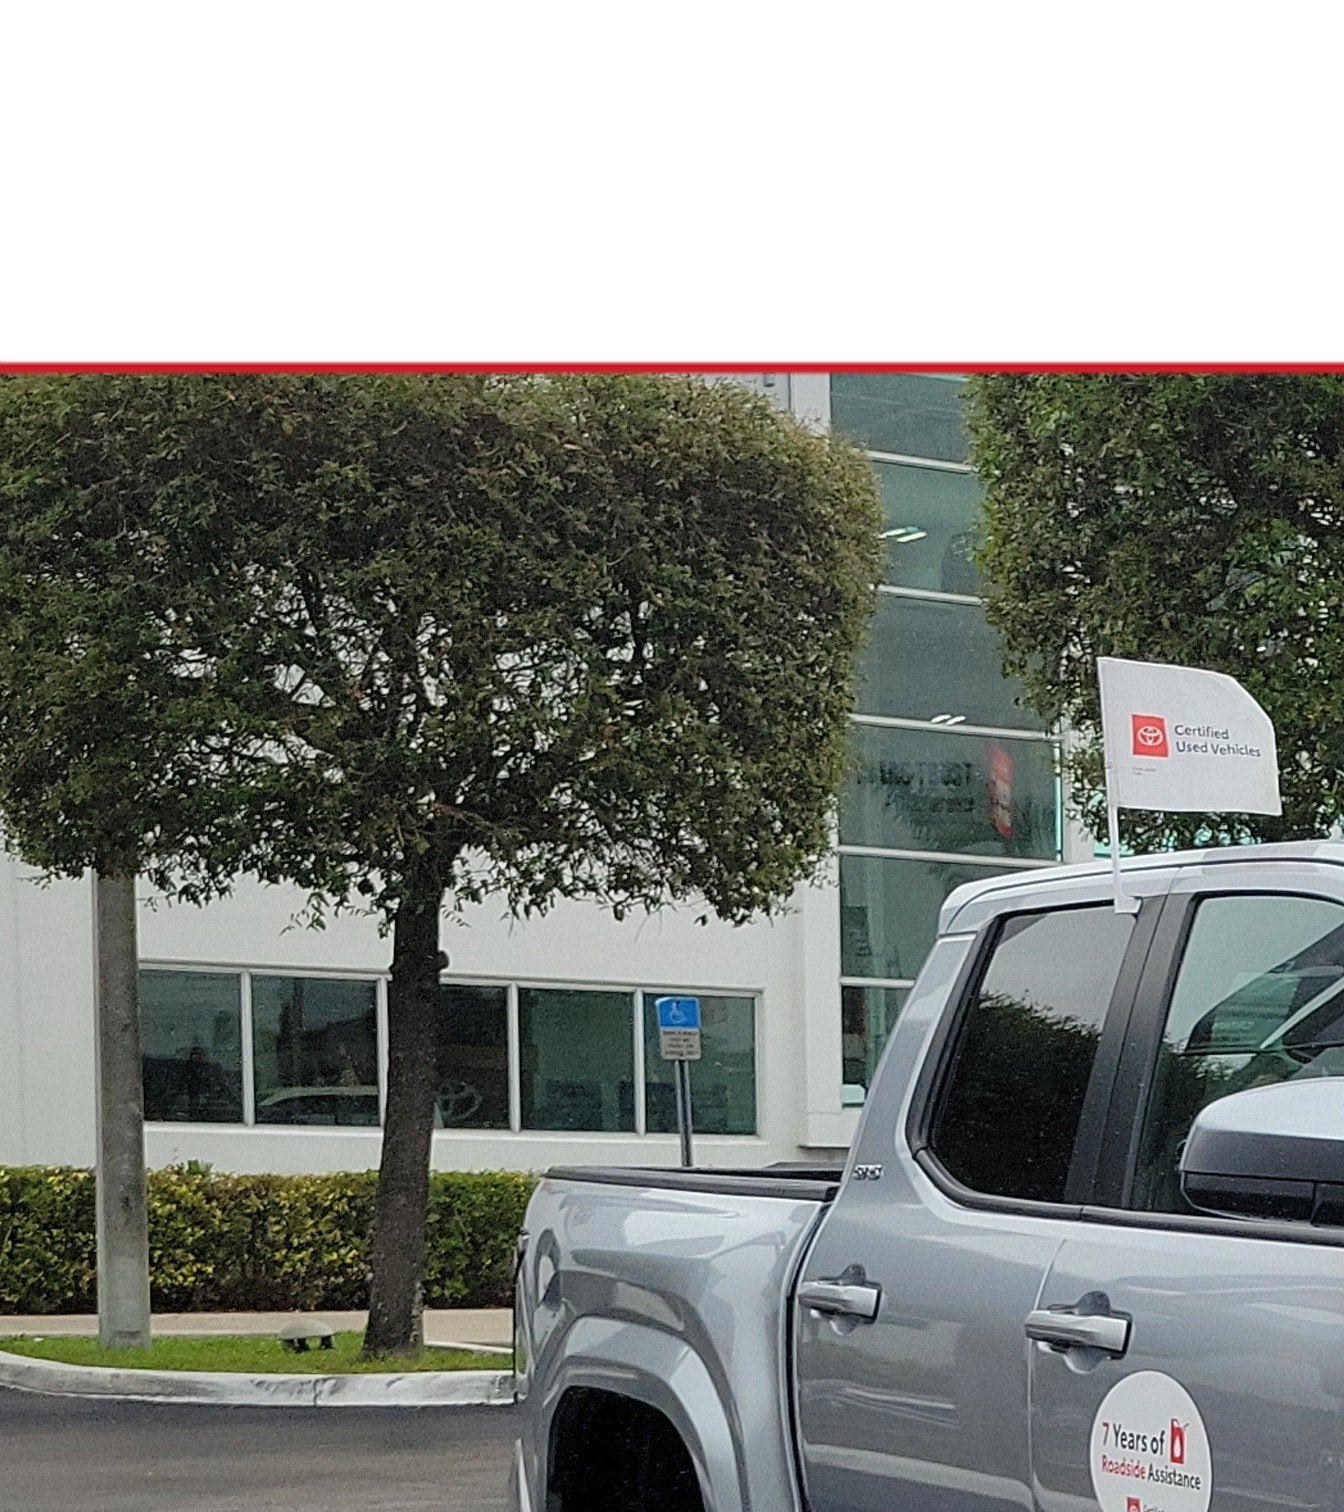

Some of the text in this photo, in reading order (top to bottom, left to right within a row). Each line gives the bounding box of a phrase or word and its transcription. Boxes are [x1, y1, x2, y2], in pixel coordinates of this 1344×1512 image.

[1174, 724, 1230, 740] Certified
[1176, 741, 1261, 757] Used Vehicles
[1101, 1421, 1166, 1456] 7 Years of
[1101, 1454, 1202, 1491] Roadside Assistance
